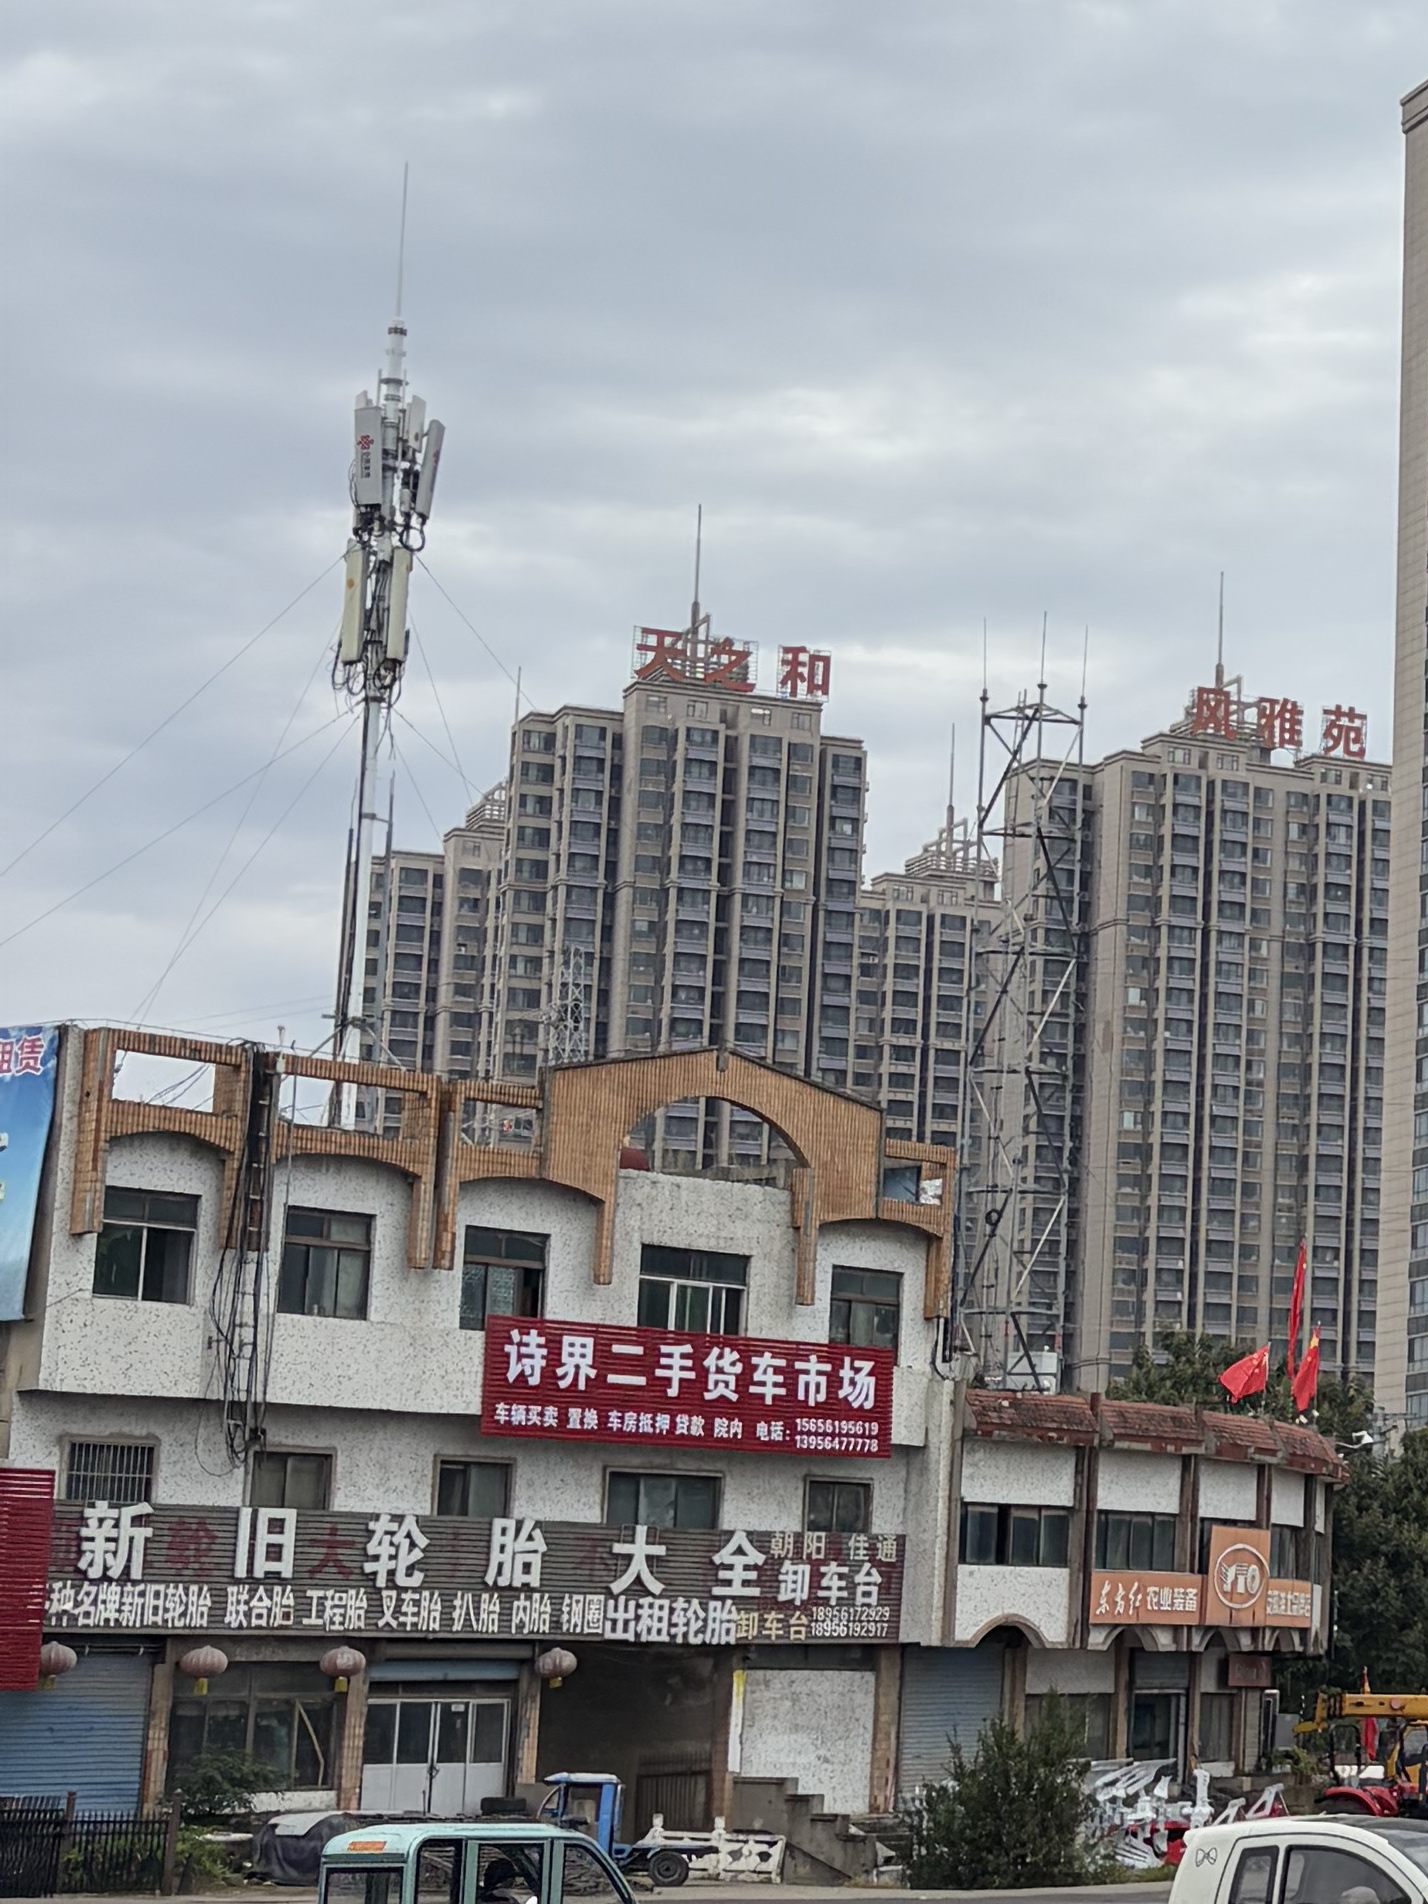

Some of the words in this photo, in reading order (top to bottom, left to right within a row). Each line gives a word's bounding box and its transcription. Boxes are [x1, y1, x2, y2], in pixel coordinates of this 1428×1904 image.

[634, 627, 831, 698] 天之和
[1191, 686, 1368, 760] 风雅苑
[504, 1328, 877, 1409] 诗界二手货车市场
[494, 1402, 559, 1427] 车辆买卖
[566, 1408, 598, 1430] 置换
[607, 1410, 670, 1436] 车房抵押
[674, 1414, 704, 1438] 贷款
[713, 1417, 742, 1439] 院内
[794, 1434, 879, 1453] 13956477778
[795, 1417, 879, 1436] 15656195619
[77, 1500, 767, 1597] 新旧轮胎大全
[770, 1530, 827, 1560] 朝阳
[848, 1533, 898, 1563] 佳通
[777, 1560, 883, 1606] 卸车台
[45, 1580, 212, 1629] 种名牌新旧轮胎
[224, 1584, 296, 1629] 联合胎
[302, 1587, 368, 1632] 工程胎
[377, 1589, 442, 1632] 叉车胎
[451, 1591, 501, 1634] 扒胎
[511, 1592, 551, 1635] 内胎
[562, 1593, 605, 1634] 钢圈
[603, 1596, 738, 1645] 出租轮胎
[735, 1610, 810, 1642] 卸车台
